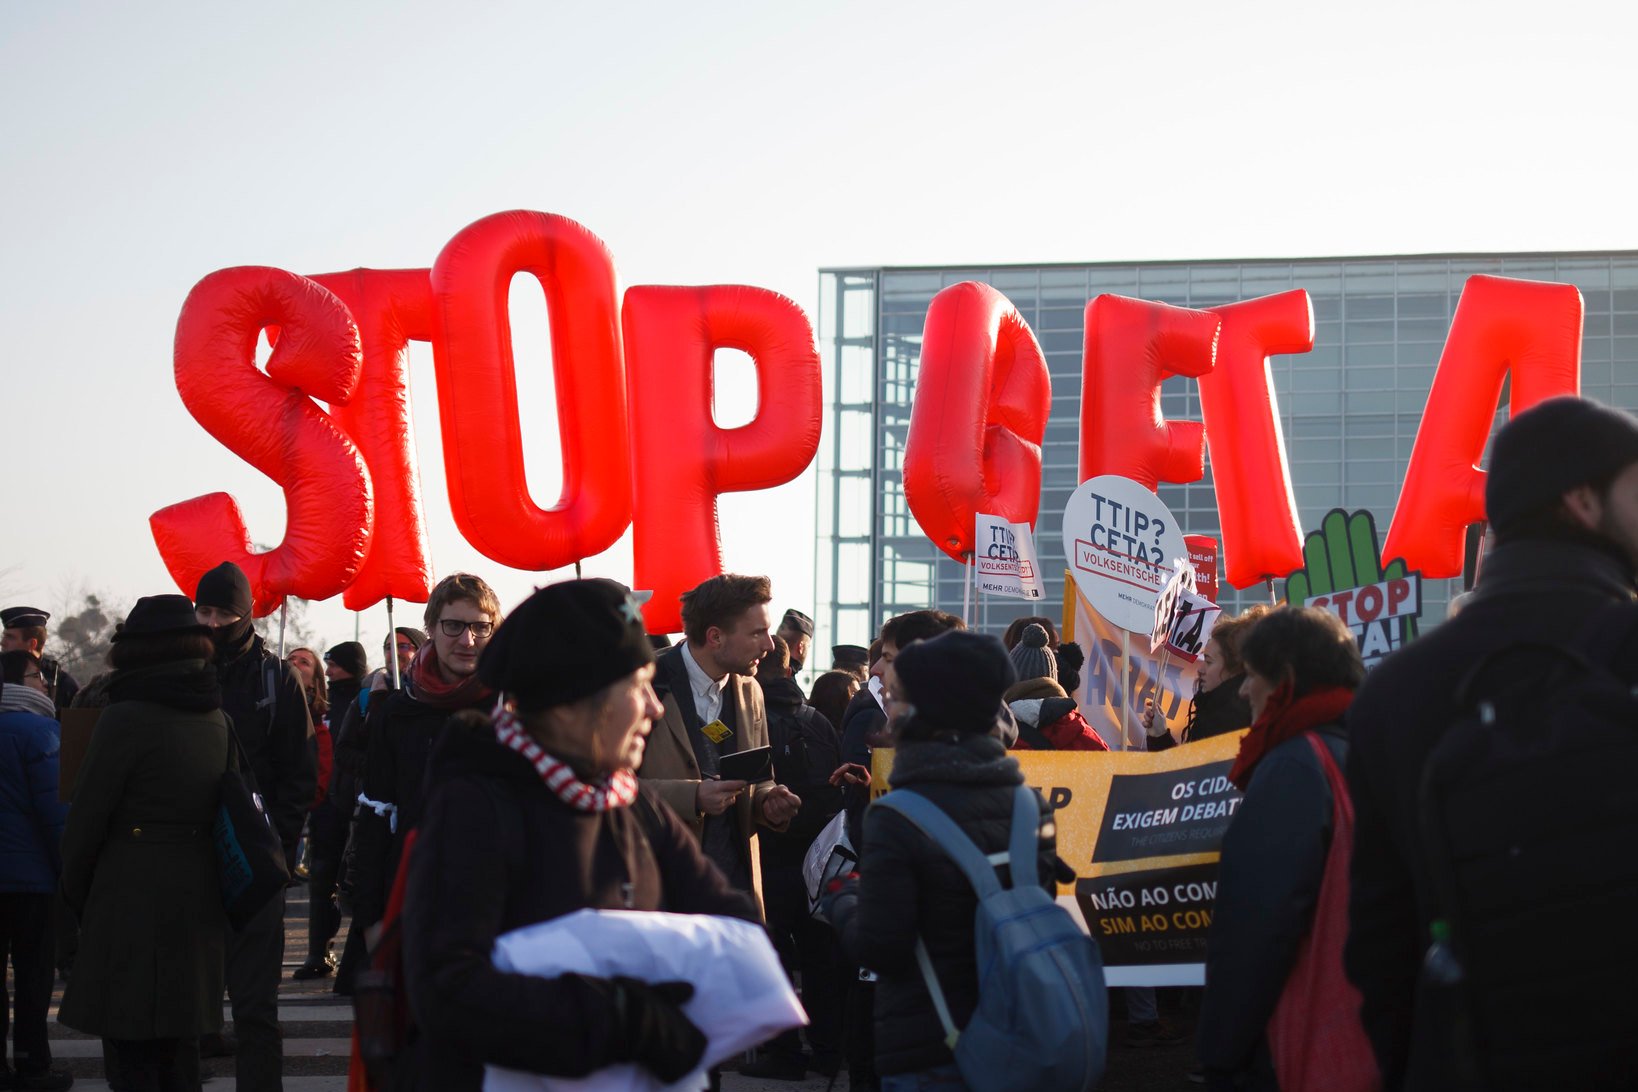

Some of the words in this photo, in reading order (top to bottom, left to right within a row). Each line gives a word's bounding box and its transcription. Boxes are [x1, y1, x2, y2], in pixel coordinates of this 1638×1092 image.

[150, 210, 822, 635] STOP
[1091, 492, 1165, 546] TTIP?
[1091, 523, 1164, 574] CETA?
[1083, 551, 1160, 586] VOLKSENTSCHE
[983, 583, 1003, 592] MEHR
[1118, 592, 1132, 601] MEHR
[1171, 782, 1196, 800] OS
[1112, 807, 1179, 830] EXIGEM
[1180, 797, 1244, 822] DEBAT
[1091, 886, 1136, 911] NÃO
[1141, 887, 1169, 906] AO
[1100, 916, 1137, 935] SIM
[1141, 914, 1169, 932] AO
